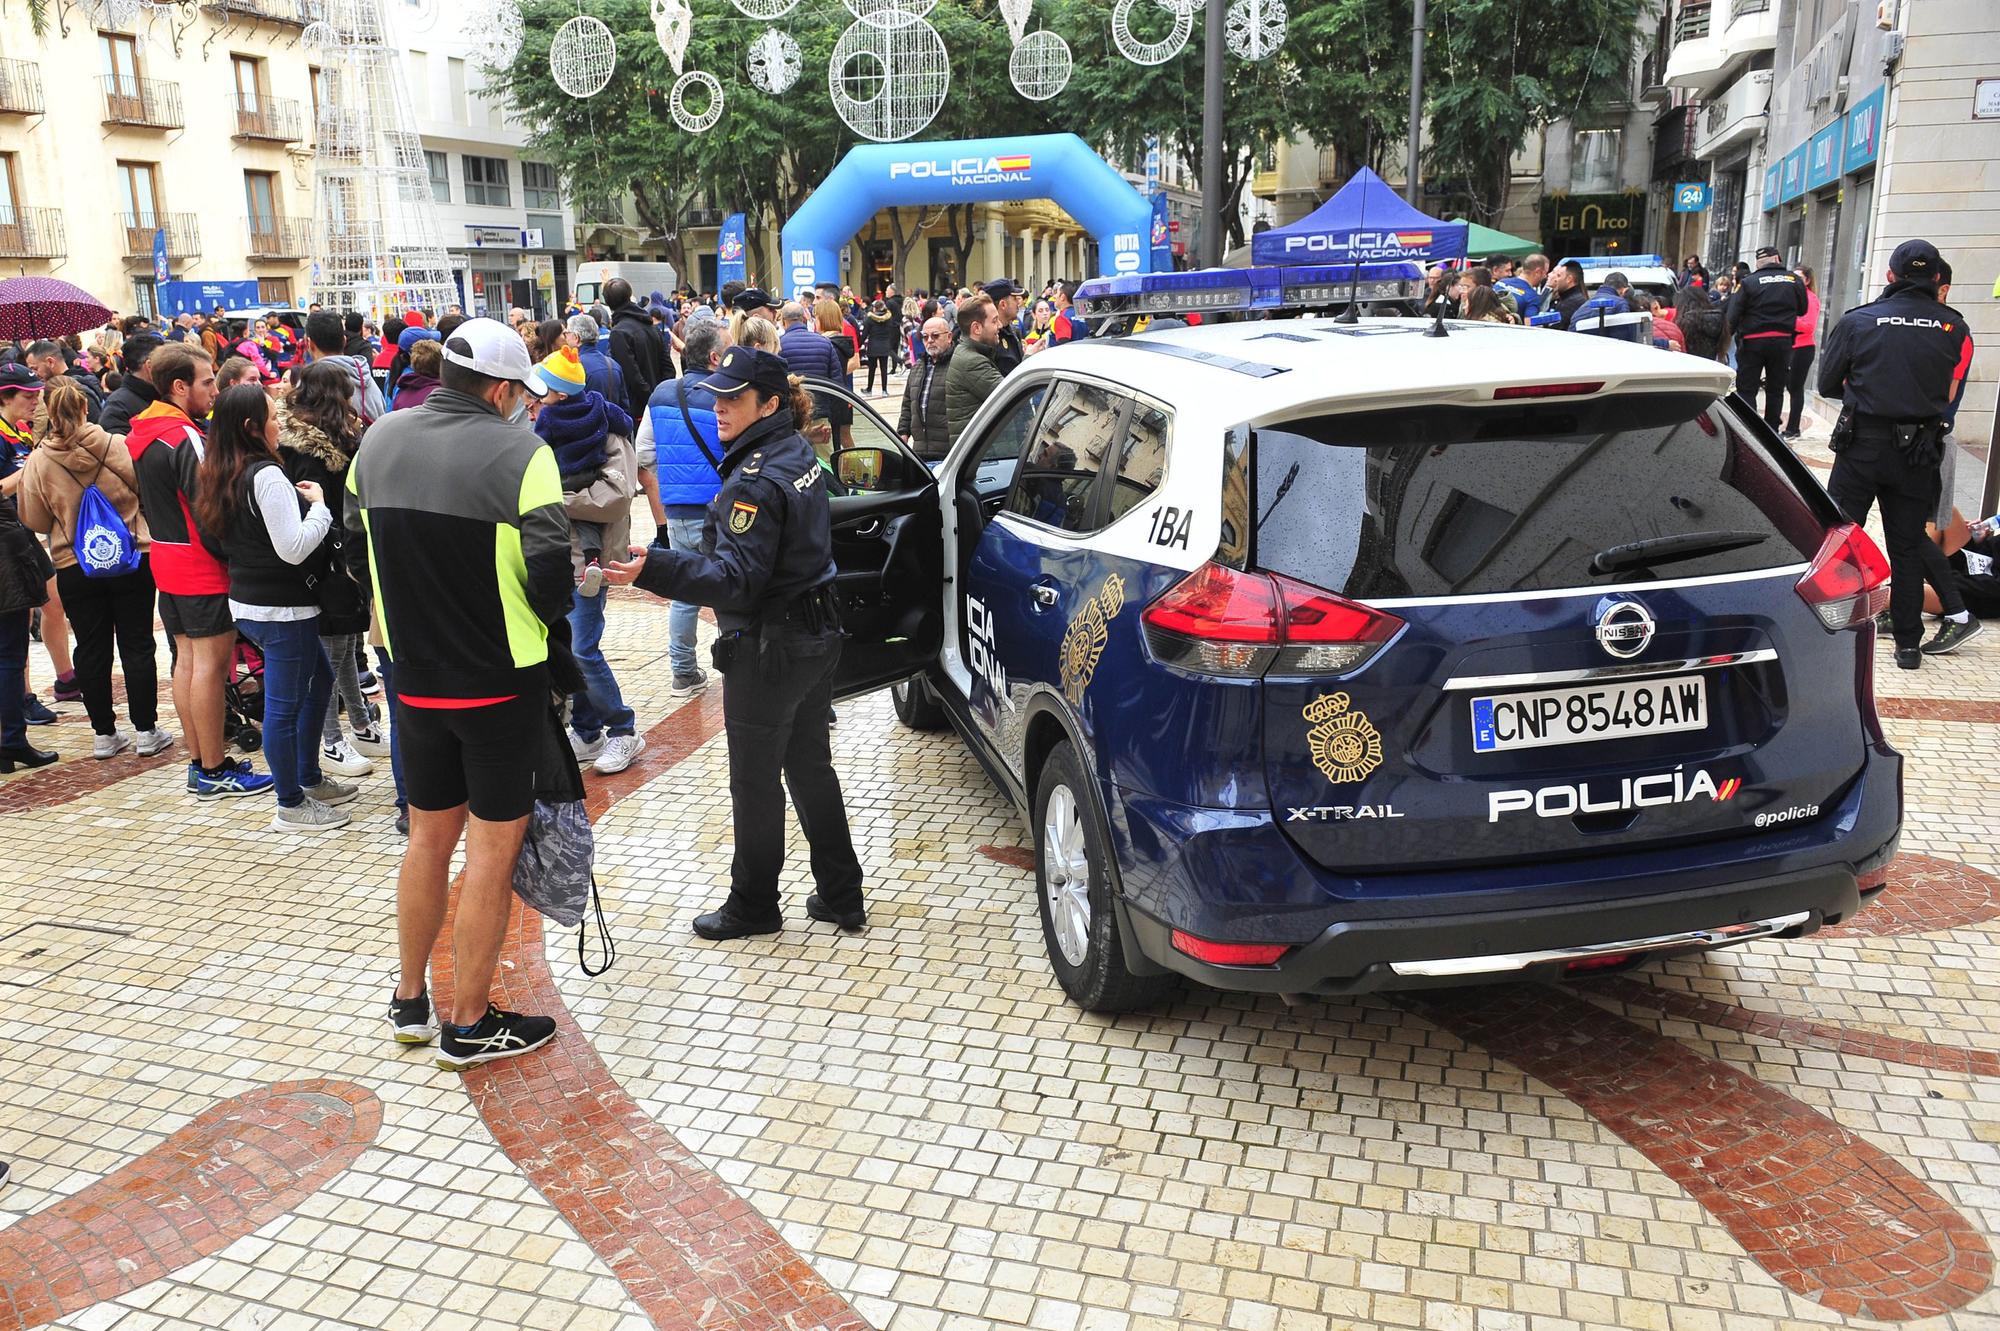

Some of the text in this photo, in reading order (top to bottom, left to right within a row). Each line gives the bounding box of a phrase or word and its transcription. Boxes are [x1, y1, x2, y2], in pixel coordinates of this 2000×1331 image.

[890, 157, 1002, 179] POLICIA
[952, 172, 1031, 186] NACIONAL
[1559, 216, 1573, 230] El
[1114, 233, 1140, 252] RUTA
[792, 250, 815, 266] RUTA
[1348, 248, 1430, 259] NACIONAL
[1877, 317, 1942, 328] POLICIA
[1148, 506, 1193, 550] 1BA
[1604, 624, 1651, 638] NISSAN
[1489, 764, 1719, 823] POLICÍA
[1286, 804, 1405, 821] X-TRAIL
[1754, 804, 1820, 828] @policia
